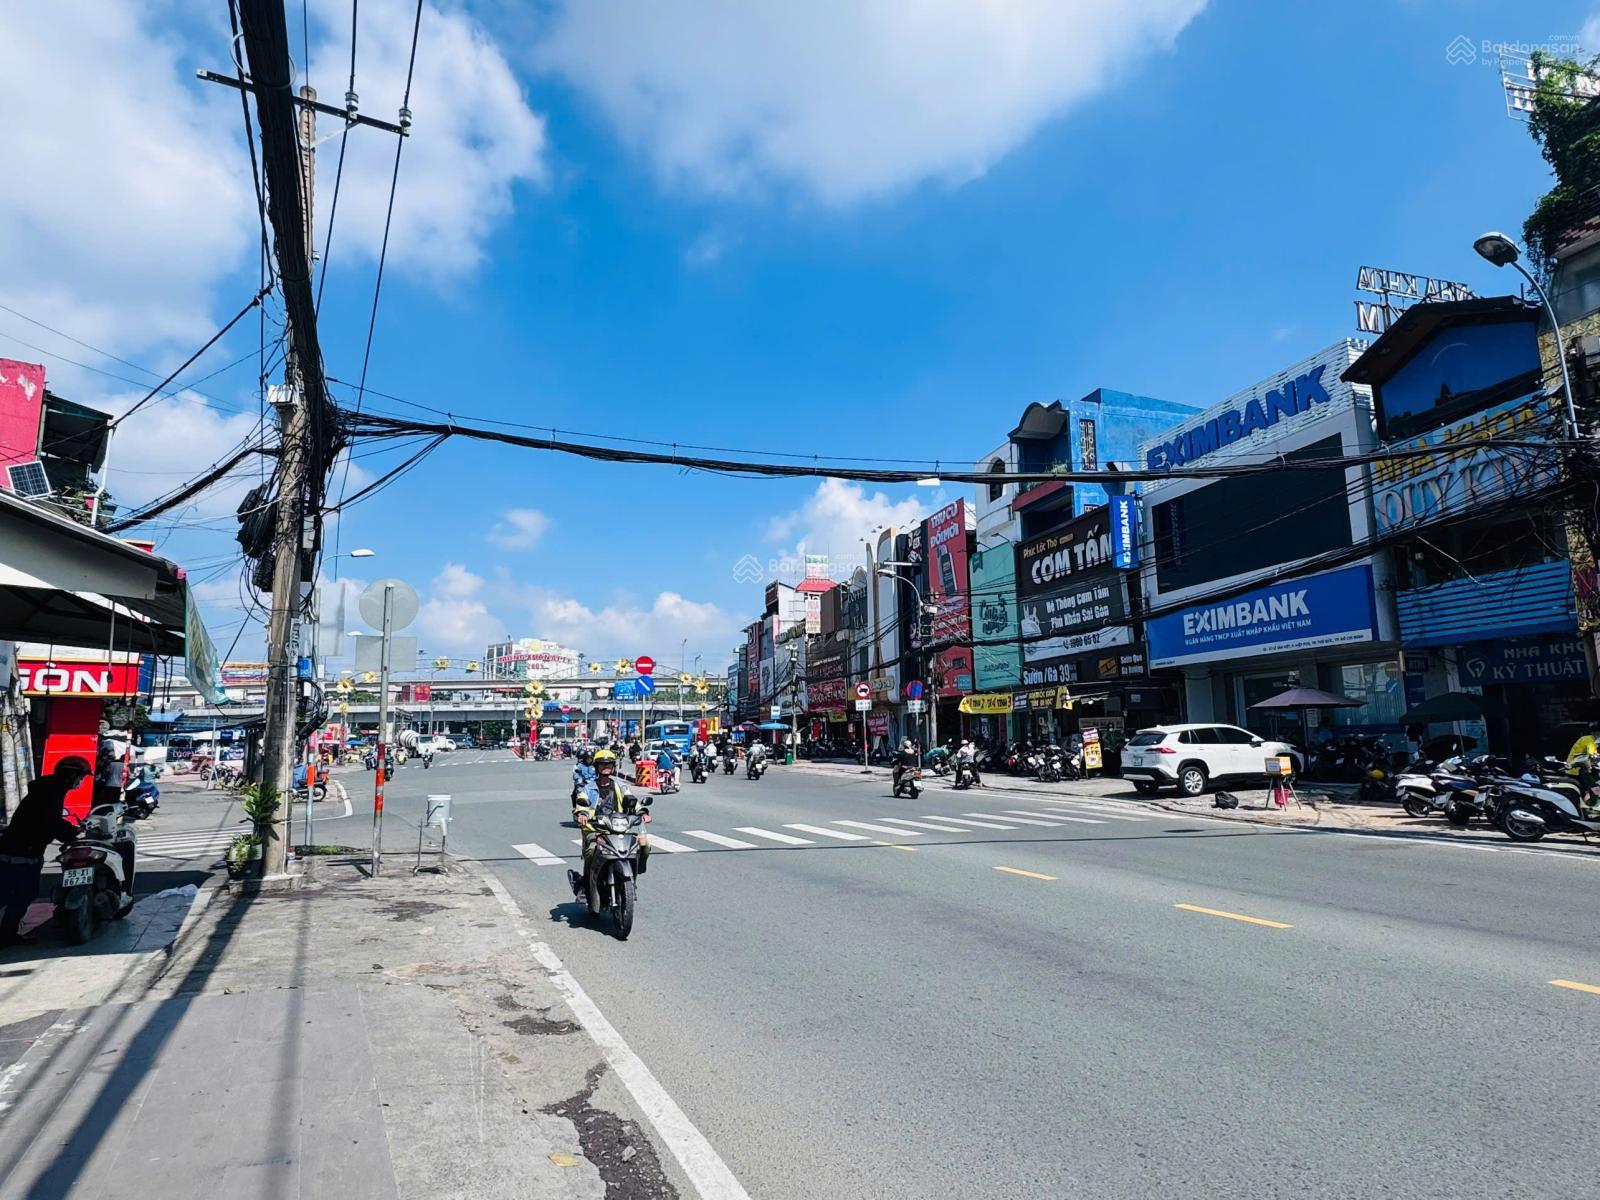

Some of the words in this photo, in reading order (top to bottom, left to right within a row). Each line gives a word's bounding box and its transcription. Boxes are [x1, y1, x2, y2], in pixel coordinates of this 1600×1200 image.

[1147, 364, 1331, 470] EXIMBANK
[1031, 548, 1072, 585] CƠM
[1183, 590, 1310, 635] EXIMBANK
[1296, 619, 1312, 628] NAM
[1504, 646, 1540, 659] NHA
[1524, 657, 1584, 679] THUẬT
